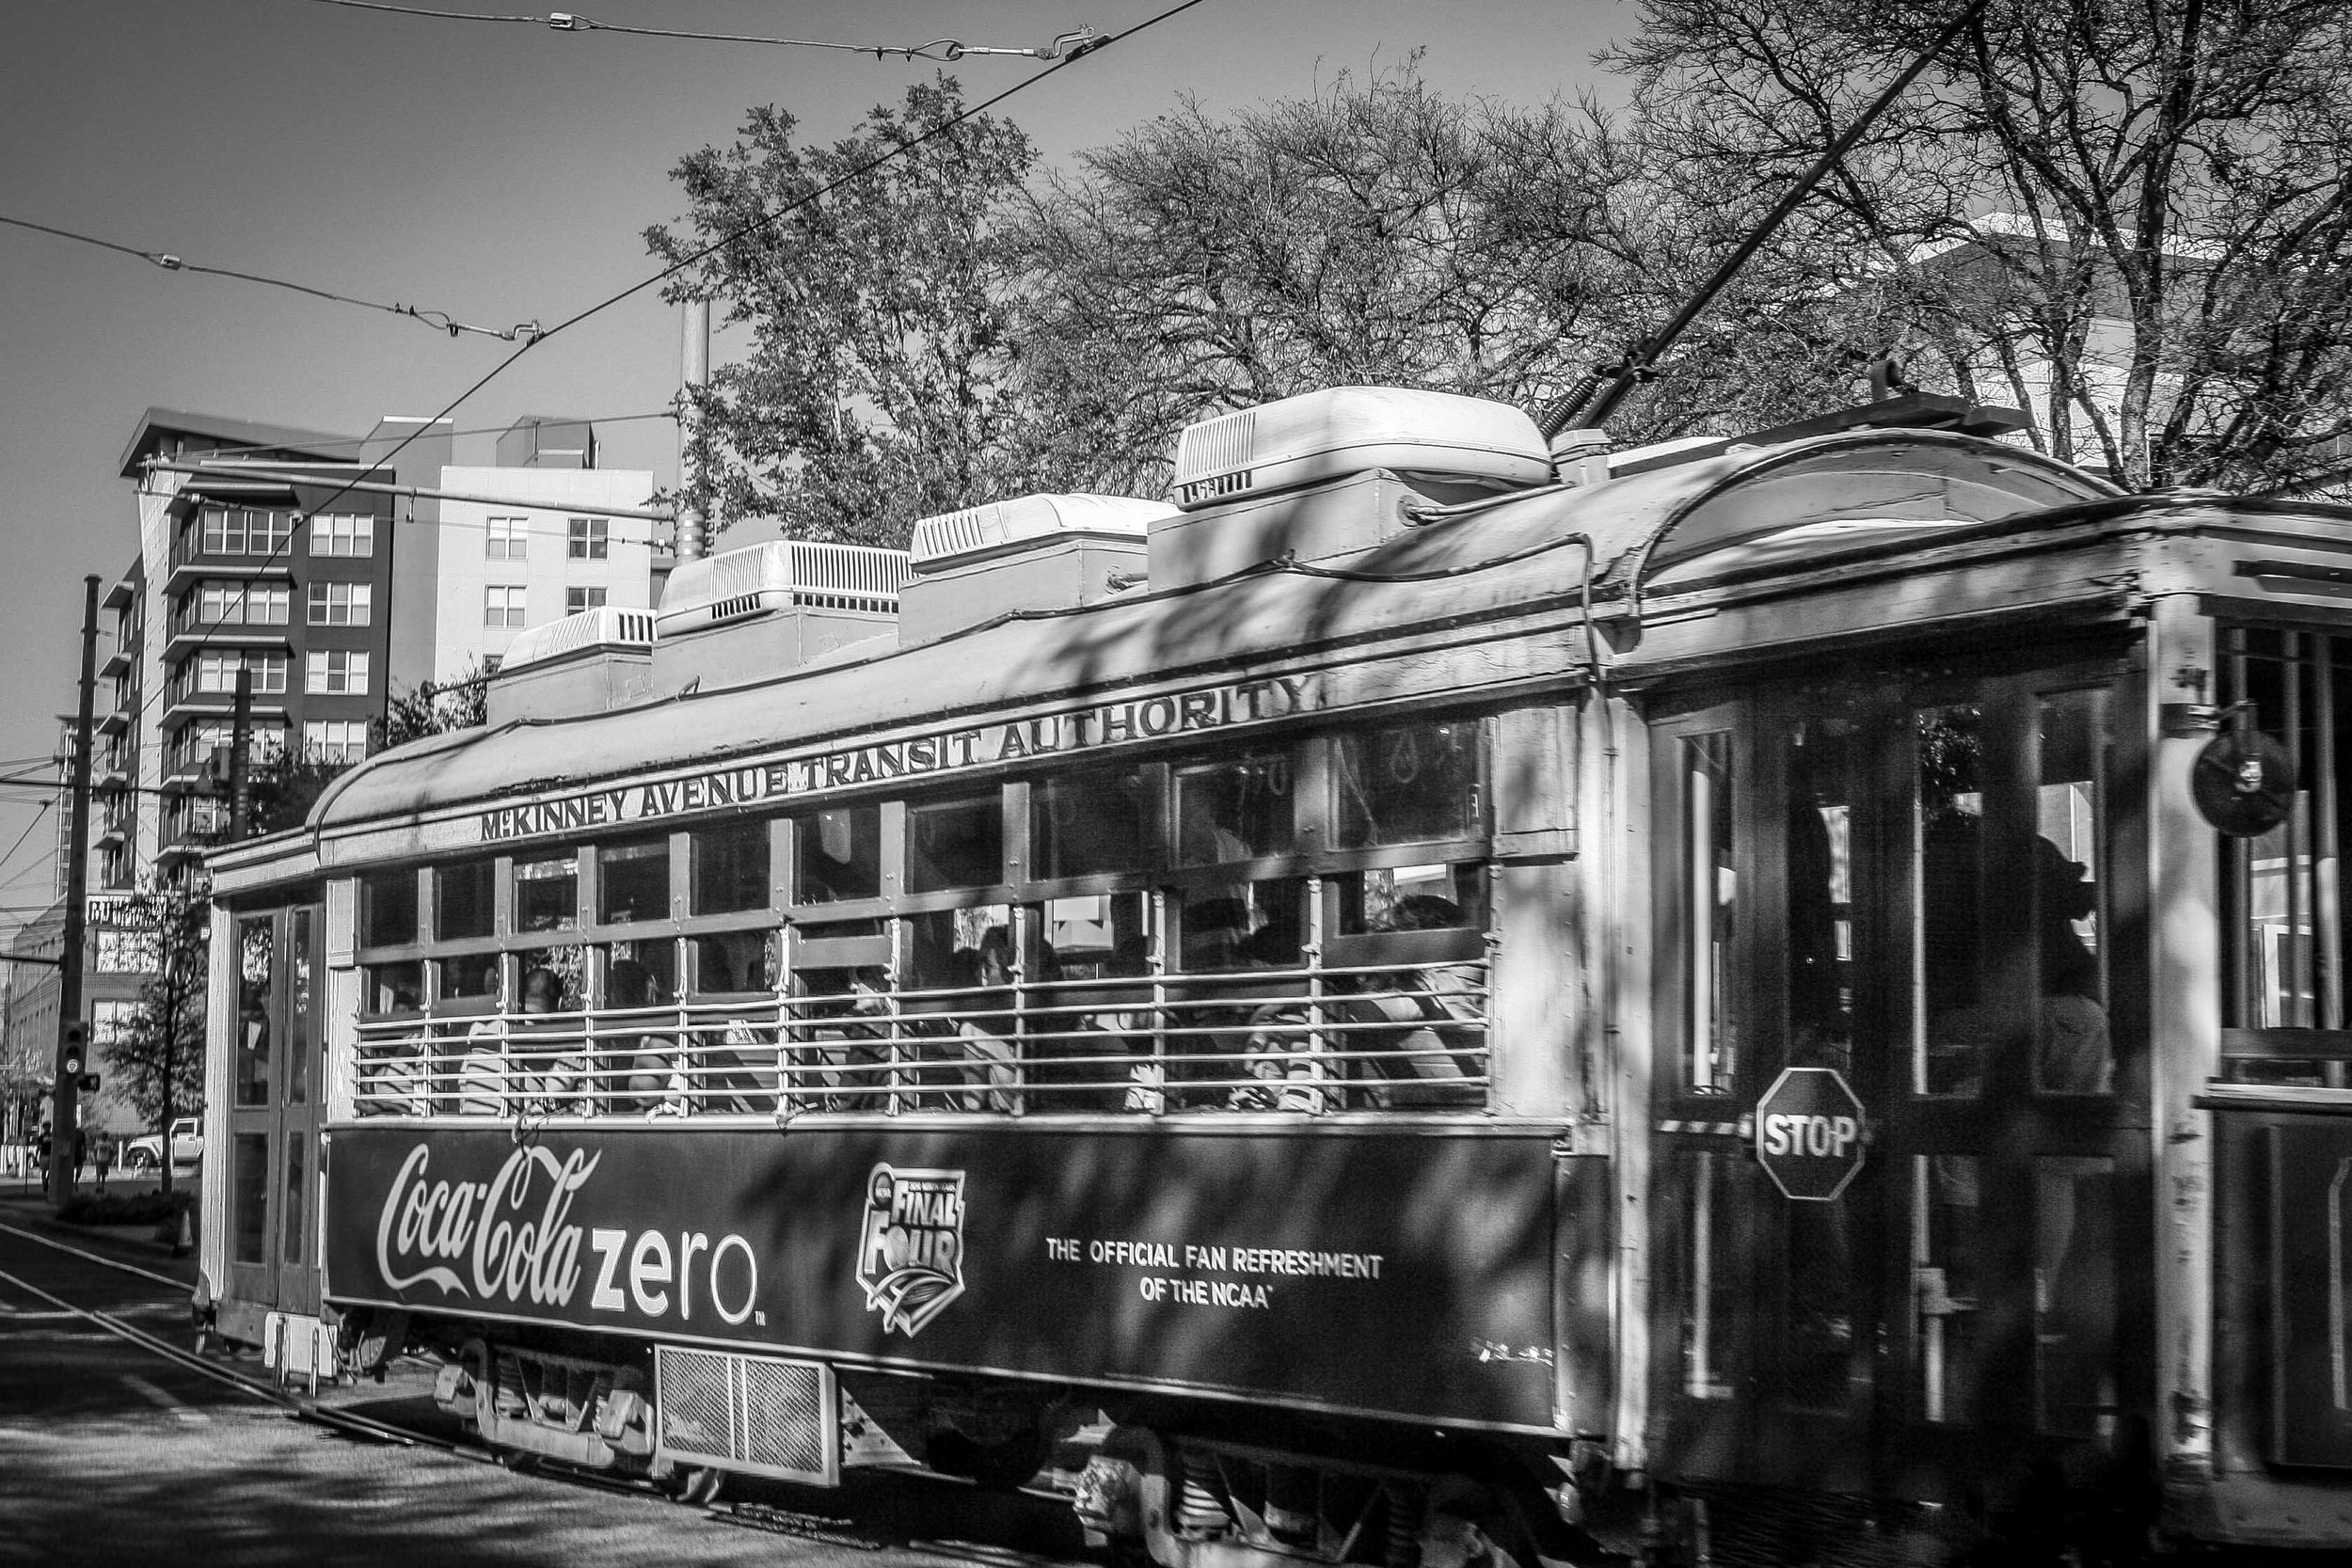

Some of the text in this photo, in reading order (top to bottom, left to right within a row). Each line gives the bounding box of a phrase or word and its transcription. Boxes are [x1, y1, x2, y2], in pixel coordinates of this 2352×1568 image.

[639, 766, 787, 817] AVENUE
[803, 729, 982, 790] TRANSIT
[997, 673, 1319, 760] AUTHORITY
[1765, 1114, 1857, 1157] STOP
[891, 1180, 957, 1227] FINAL
[376, 1143, 602, 1308] Coca-Cola
[591, 1227, 758, 1325] zero
[864, 1210, 956, 1278] FOUR
[1045, 1237, 1384, 1279] THE OFFICIAL FAN REFRESHMENT
[1139, 1276, 1168, 1302] OF
[1170, 1278, 1209, 1305] THE
